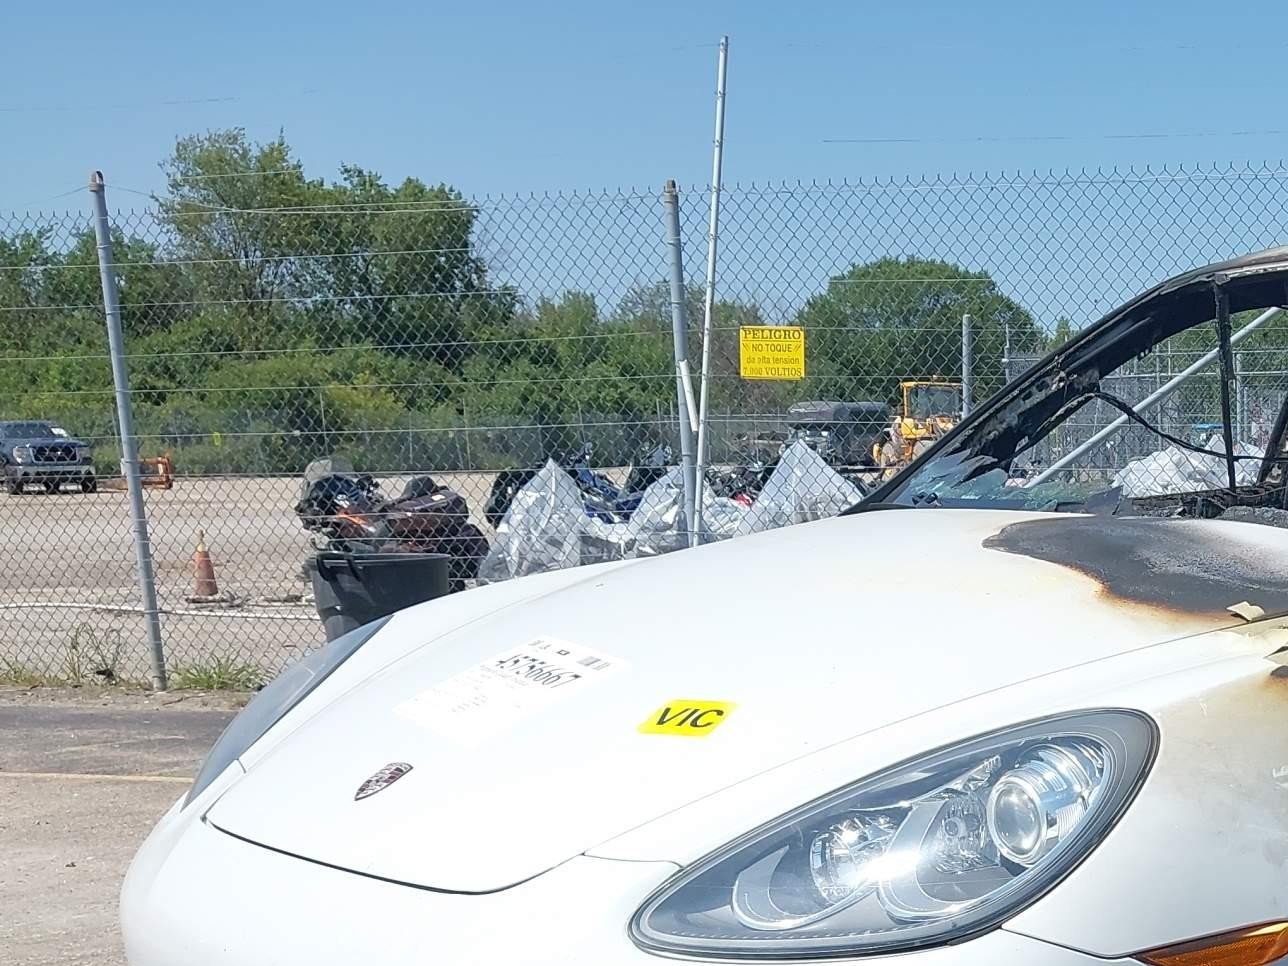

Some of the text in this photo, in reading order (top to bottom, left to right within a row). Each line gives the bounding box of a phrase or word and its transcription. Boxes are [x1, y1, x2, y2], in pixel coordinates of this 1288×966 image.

[743, 329, 801, 340] PELIGRO
[752, 343, 793, 353] NO TOQUE
[764, 367, 802, 377] VOLTIOS
[496, 653, 582, 688] 45756667
[655, 707, 724, 729] VIC
